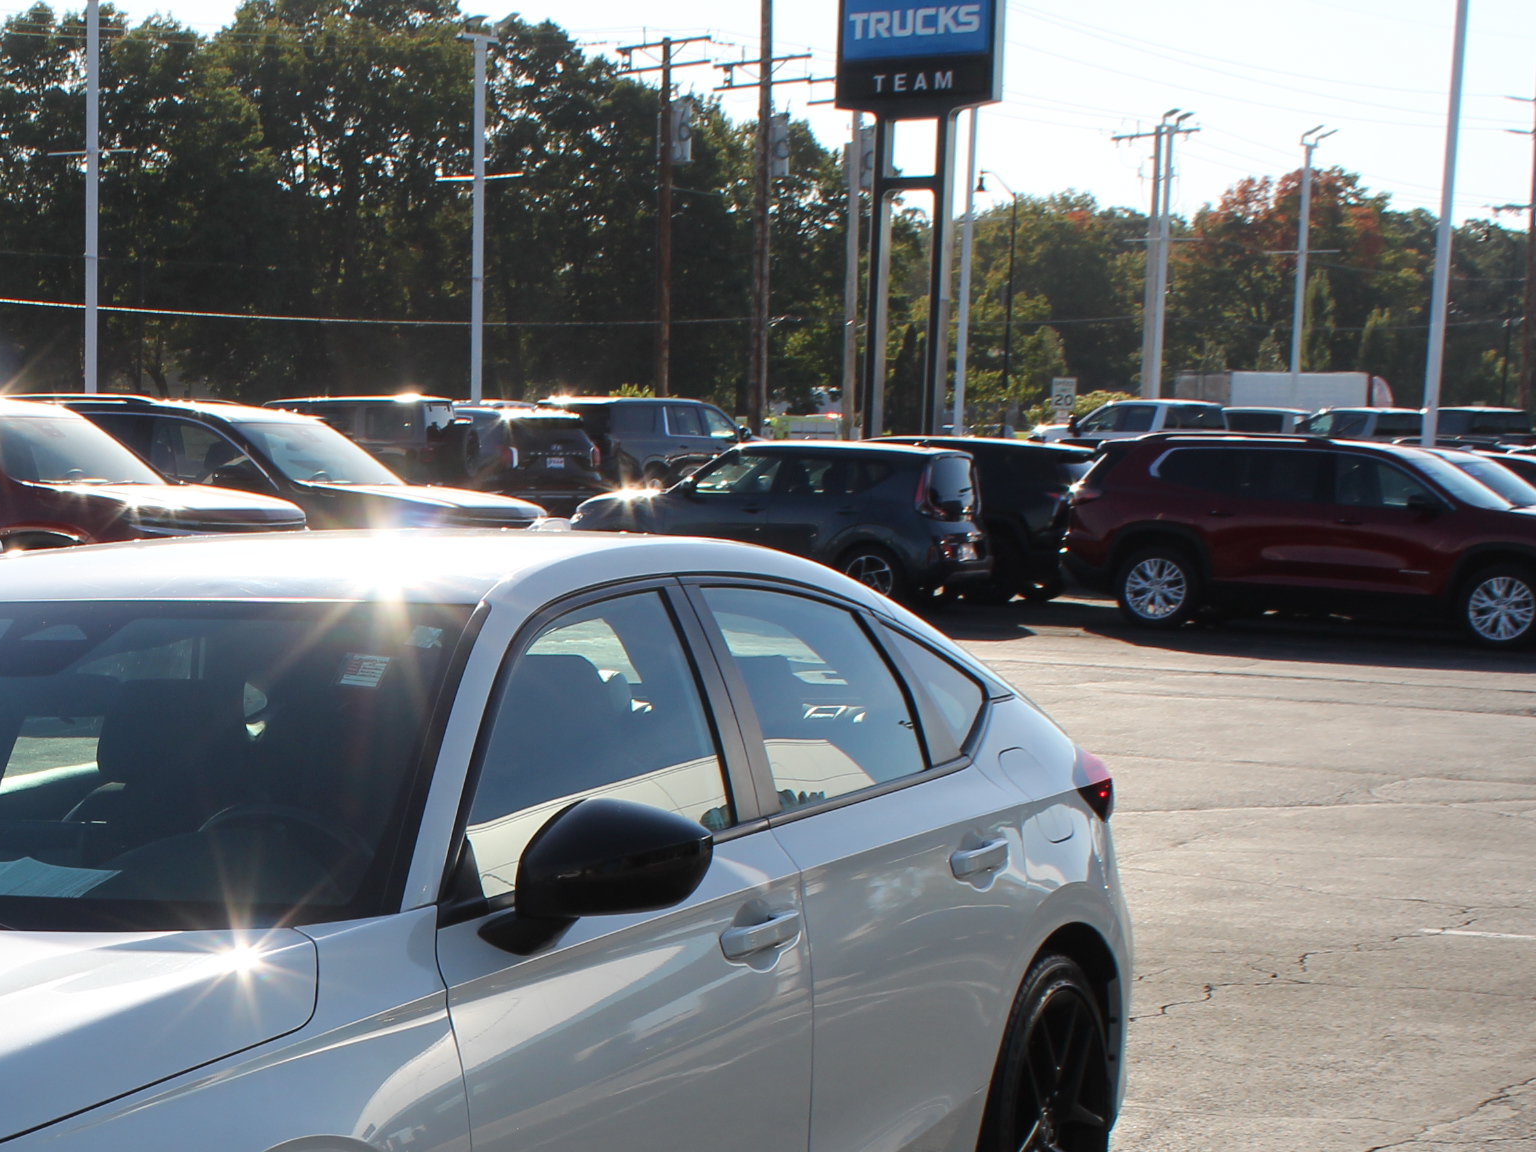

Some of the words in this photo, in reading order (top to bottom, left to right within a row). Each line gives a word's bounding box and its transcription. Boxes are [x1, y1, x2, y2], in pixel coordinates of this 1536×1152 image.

[849, 4, 981, 40] TRUCKS
[873, 70, 954, 93] TEAM
[1055, 393, 1074, 406] 20
